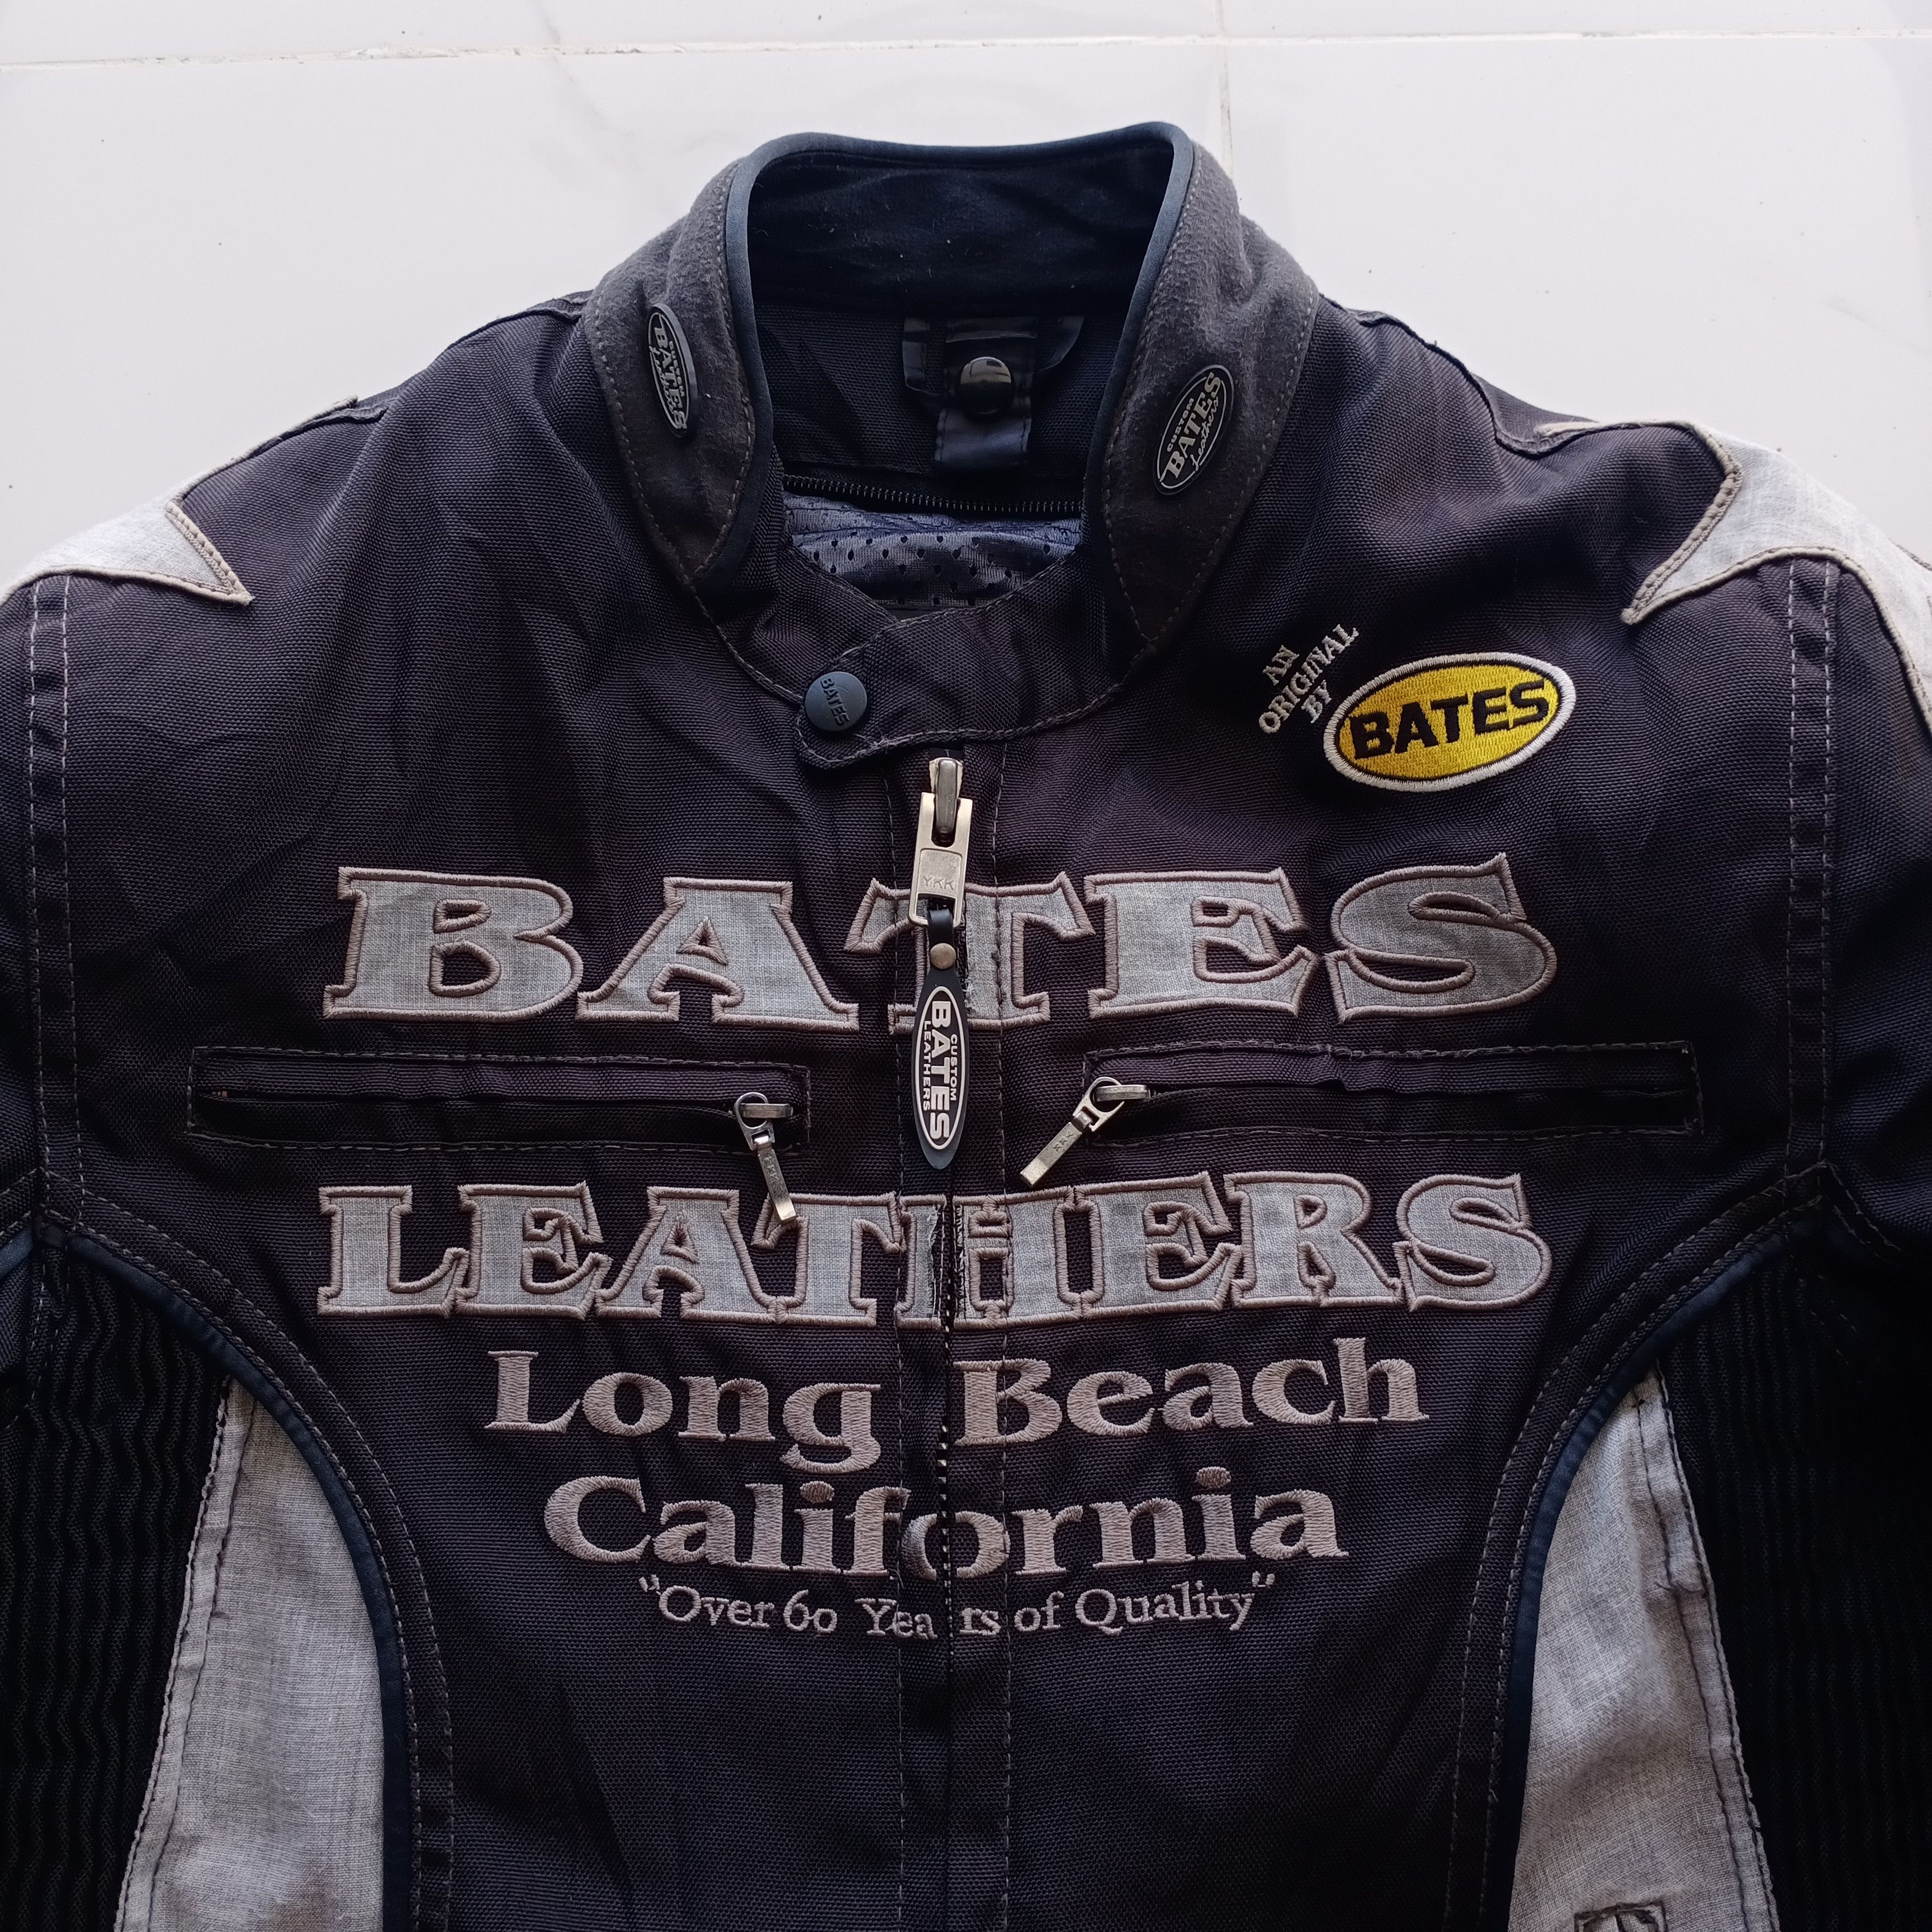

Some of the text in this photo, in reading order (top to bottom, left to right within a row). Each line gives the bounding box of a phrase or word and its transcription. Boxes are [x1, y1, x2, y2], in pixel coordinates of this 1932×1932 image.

[654, 321, 688, 429] BATES
[1159, 372, 1221, 482] BATES
[1167, 398, 1194, 452] CUSTOM
[820, 676, 850, 726] BATES
[1258, 623, 1360, 733] ORIGINAL
[1262, 644, 1300, 686] AN
[1301, 679, 1333, 723] BY
[1348, 680, 1550, 760] BATES
[922, 875, 954, 891] YKK
[323, 853, 1556, 1034] BATES
[923, 1020, 931, 1111] LEATHERS
[930, 1001, 951, 1139] BATES
[316, 1171, 1552, 1328] LEATHERS
[485, 1337, 1429, 1474] Long Beach
[544, 1466, 1349, 1581] California
[638, 1574, 775, 1628] "Over
[1014, 1590, 1064, 1632] of
[1074, 1571, 1276, 1636] Quality"
